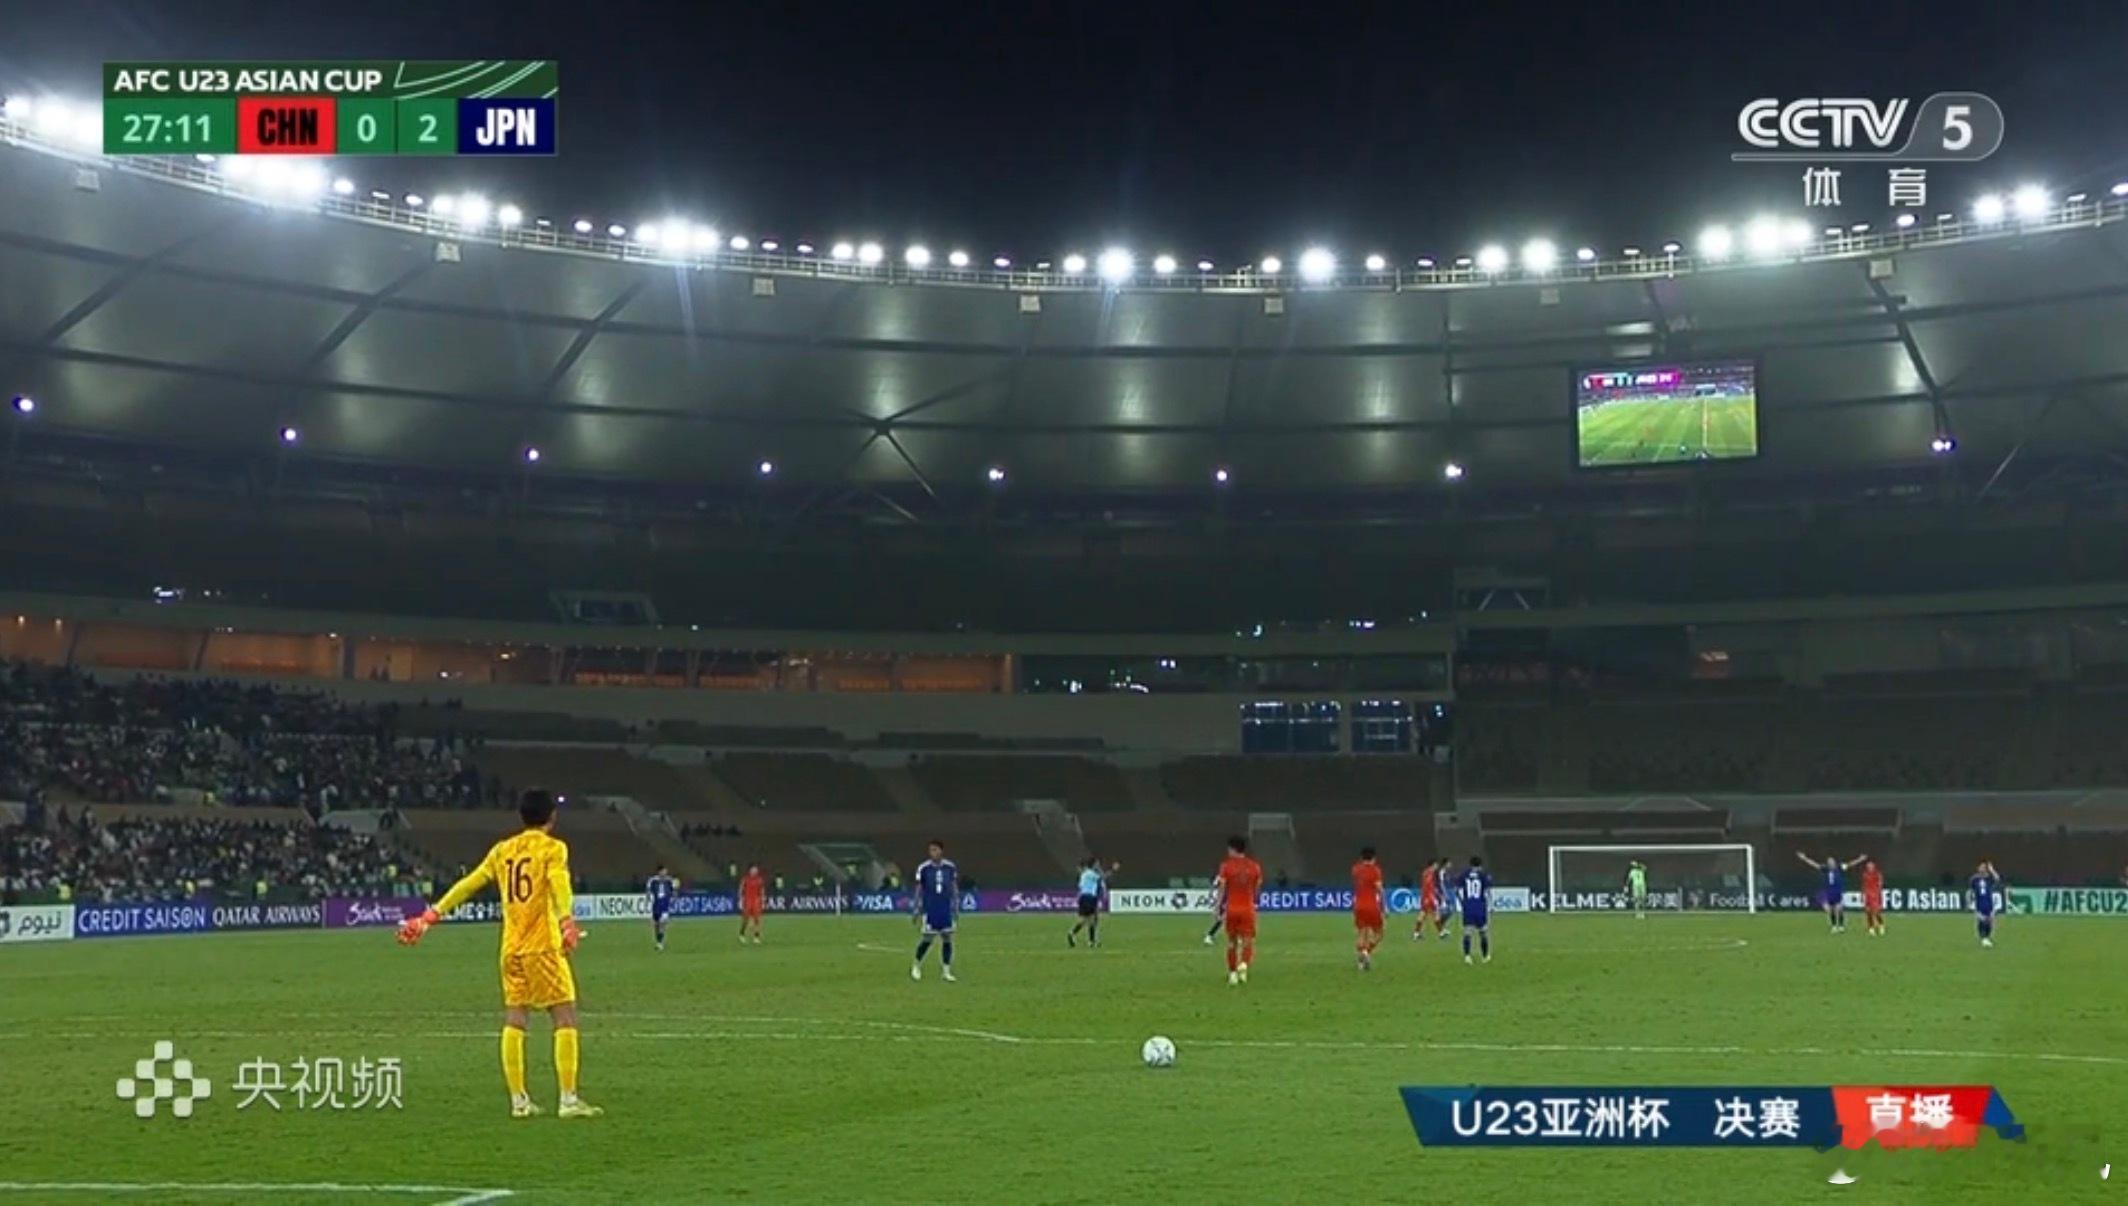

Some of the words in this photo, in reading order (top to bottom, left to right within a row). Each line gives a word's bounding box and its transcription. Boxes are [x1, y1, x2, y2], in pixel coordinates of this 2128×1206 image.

[505, 857, 533, 904] 16
[1465, 878, 1482, 899] 10
[860, 895, 893, 910] VISA
[1121, 896, 1165, 908] NEOM
[1252, 891, 1310, 908] REDIT
[1315, 891, 1353, 908] SAIS
[1709, 892, 1765, 908] Football
[1768, 892, 1811, 908] Cares
[1880, 889, 1901, 909] FC
[1907, 888, 1960, 909] Asian
[1965, 889, 2003, 912] Cp
[78, 908, 143, 932] CREDIT
[144, 906, 205, 930] SAISON
[212, 905, 261, 926] QATAR
[263, 903, 321, 925] AIRWAYS
